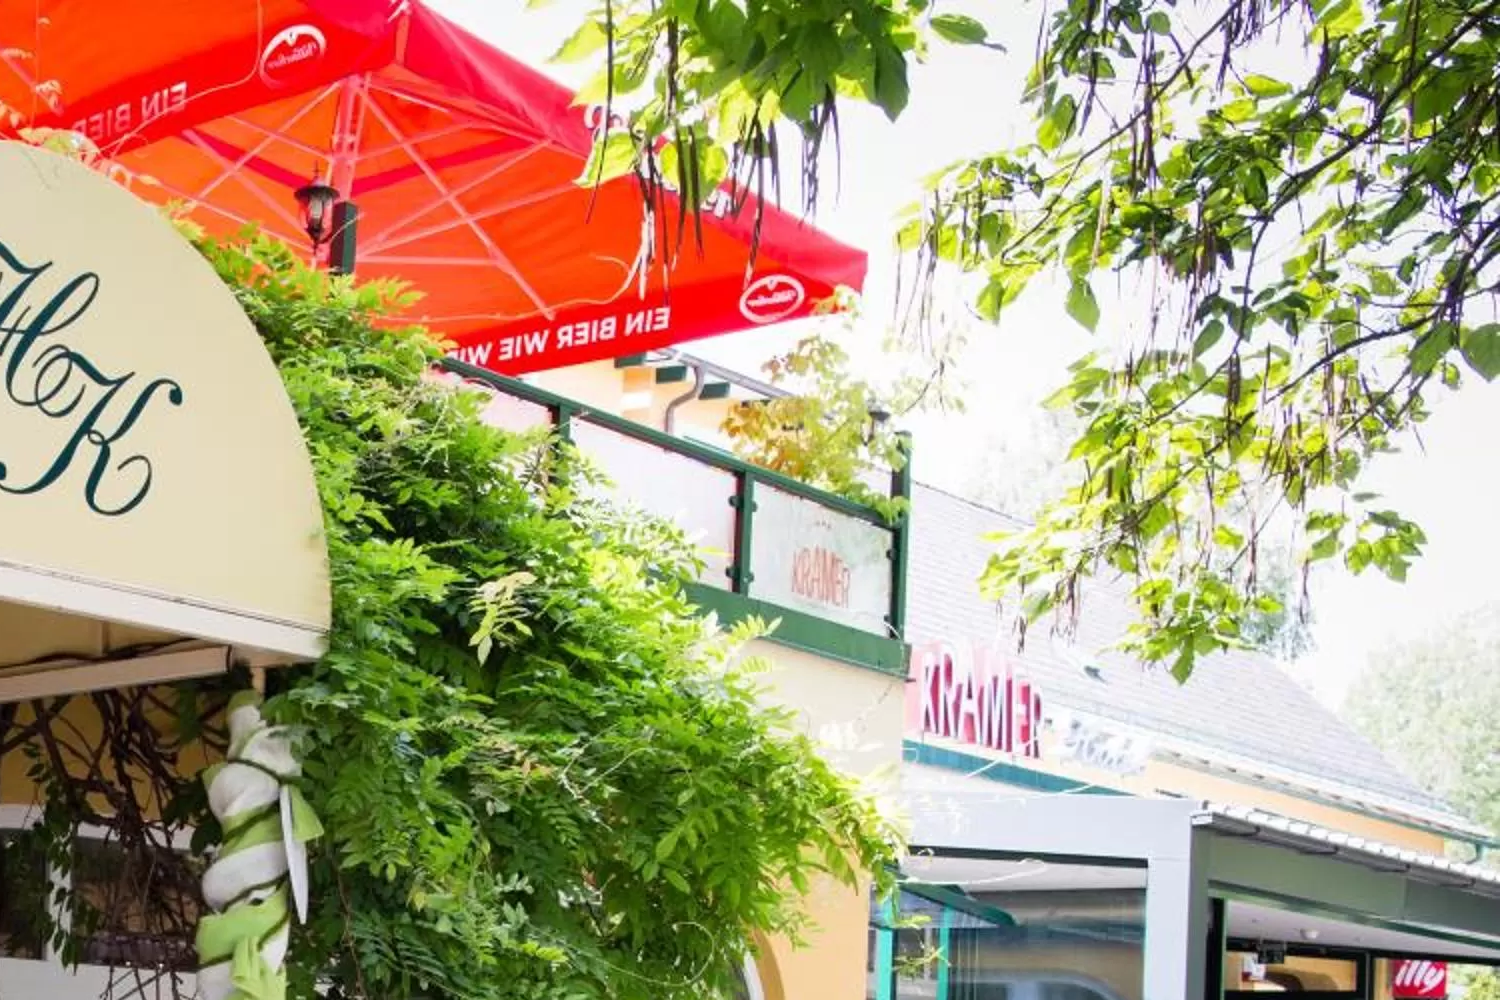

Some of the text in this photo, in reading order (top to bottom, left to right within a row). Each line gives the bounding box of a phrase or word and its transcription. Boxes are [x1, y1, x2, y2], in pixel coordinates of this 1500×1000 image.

[791, 544, 852, 609] KRAMER
[922, 643, 1046, 760] KRAMER
[1395, 960, 1446, 994] illy
